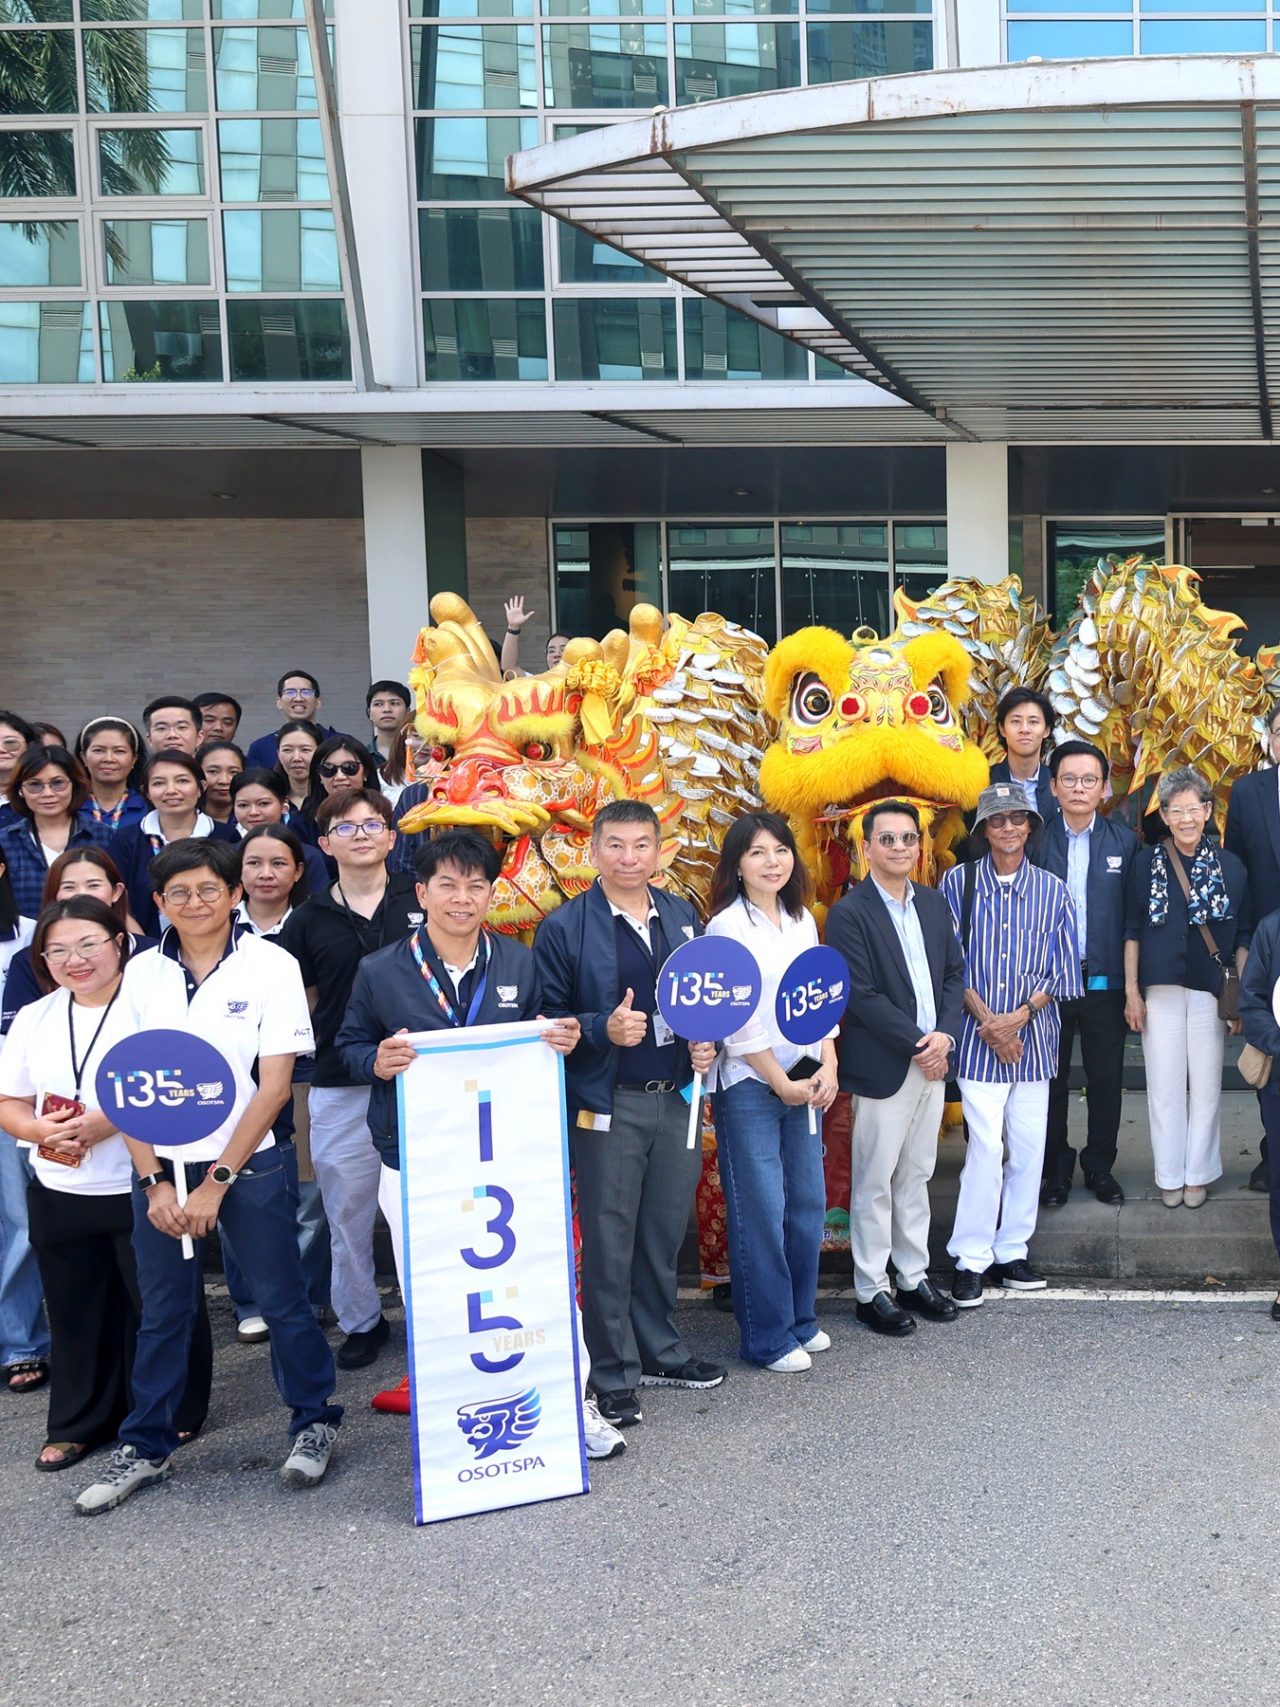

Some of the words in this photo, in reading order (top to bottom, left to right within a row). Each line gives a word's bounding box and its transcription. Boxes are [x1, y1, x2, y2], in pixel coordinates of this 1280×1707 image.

[669, 972, 725, 1006] 135
[711, 990, 730, 999] YEARS
[782, 978, 824, 1022] 135
[107, 1069, 186, 1109] 135
[168, 1089, 195, 1098] YEARS
[492, 1327, 547, 1353] YEARS
[457, 1456, 546, 1484] OSOTSPA
